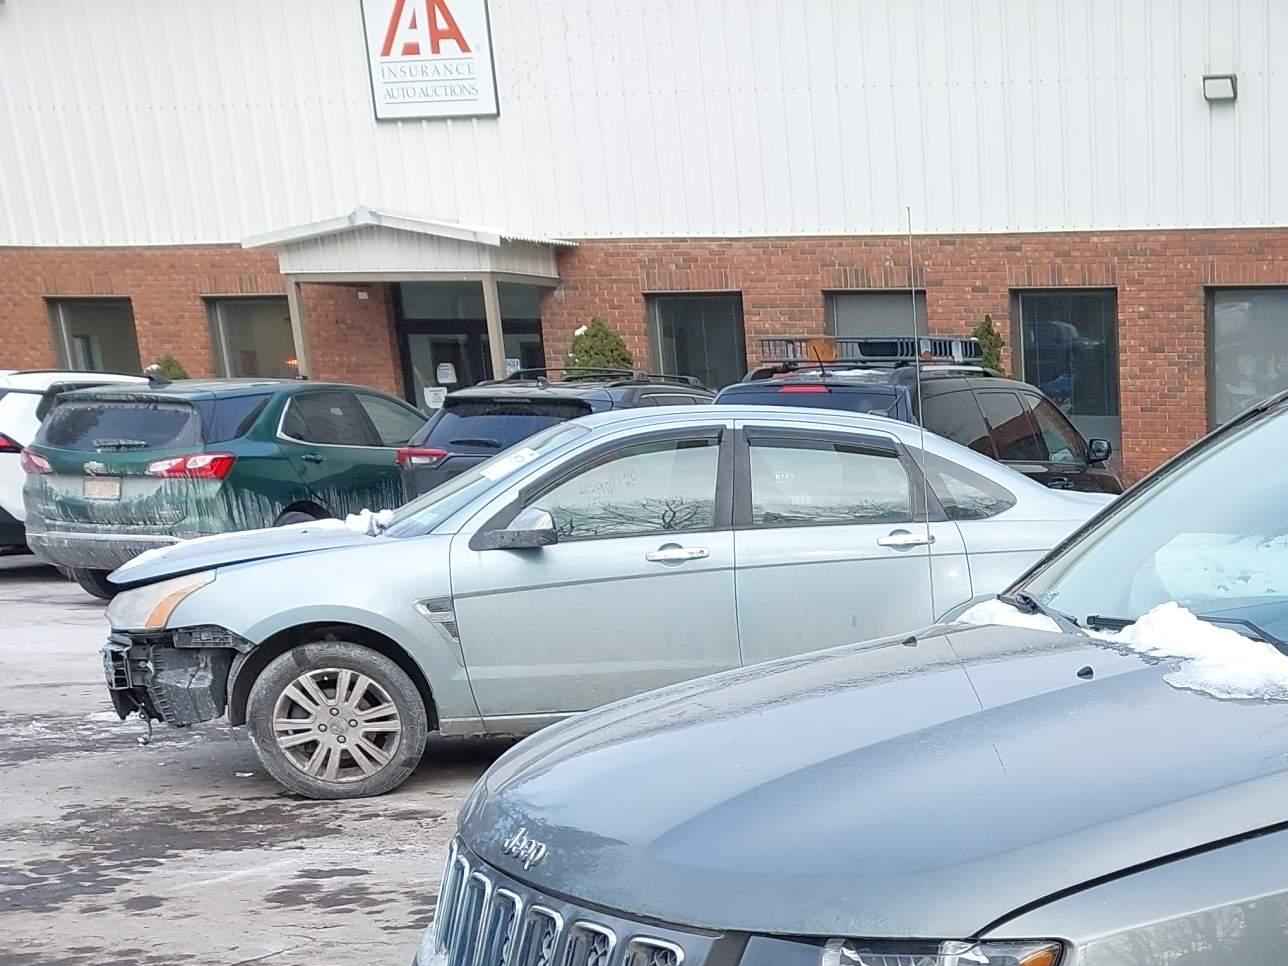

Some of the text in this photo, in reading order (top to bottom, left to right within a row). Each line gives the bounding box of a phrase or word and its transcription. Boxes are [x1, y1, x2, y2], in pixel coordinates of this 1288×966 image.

[380, 62, 475, 79] INSURANCE
[384, 82, 479, 100] AUTO AUCTIONS
[502, 826, 547, 871] Jeep
